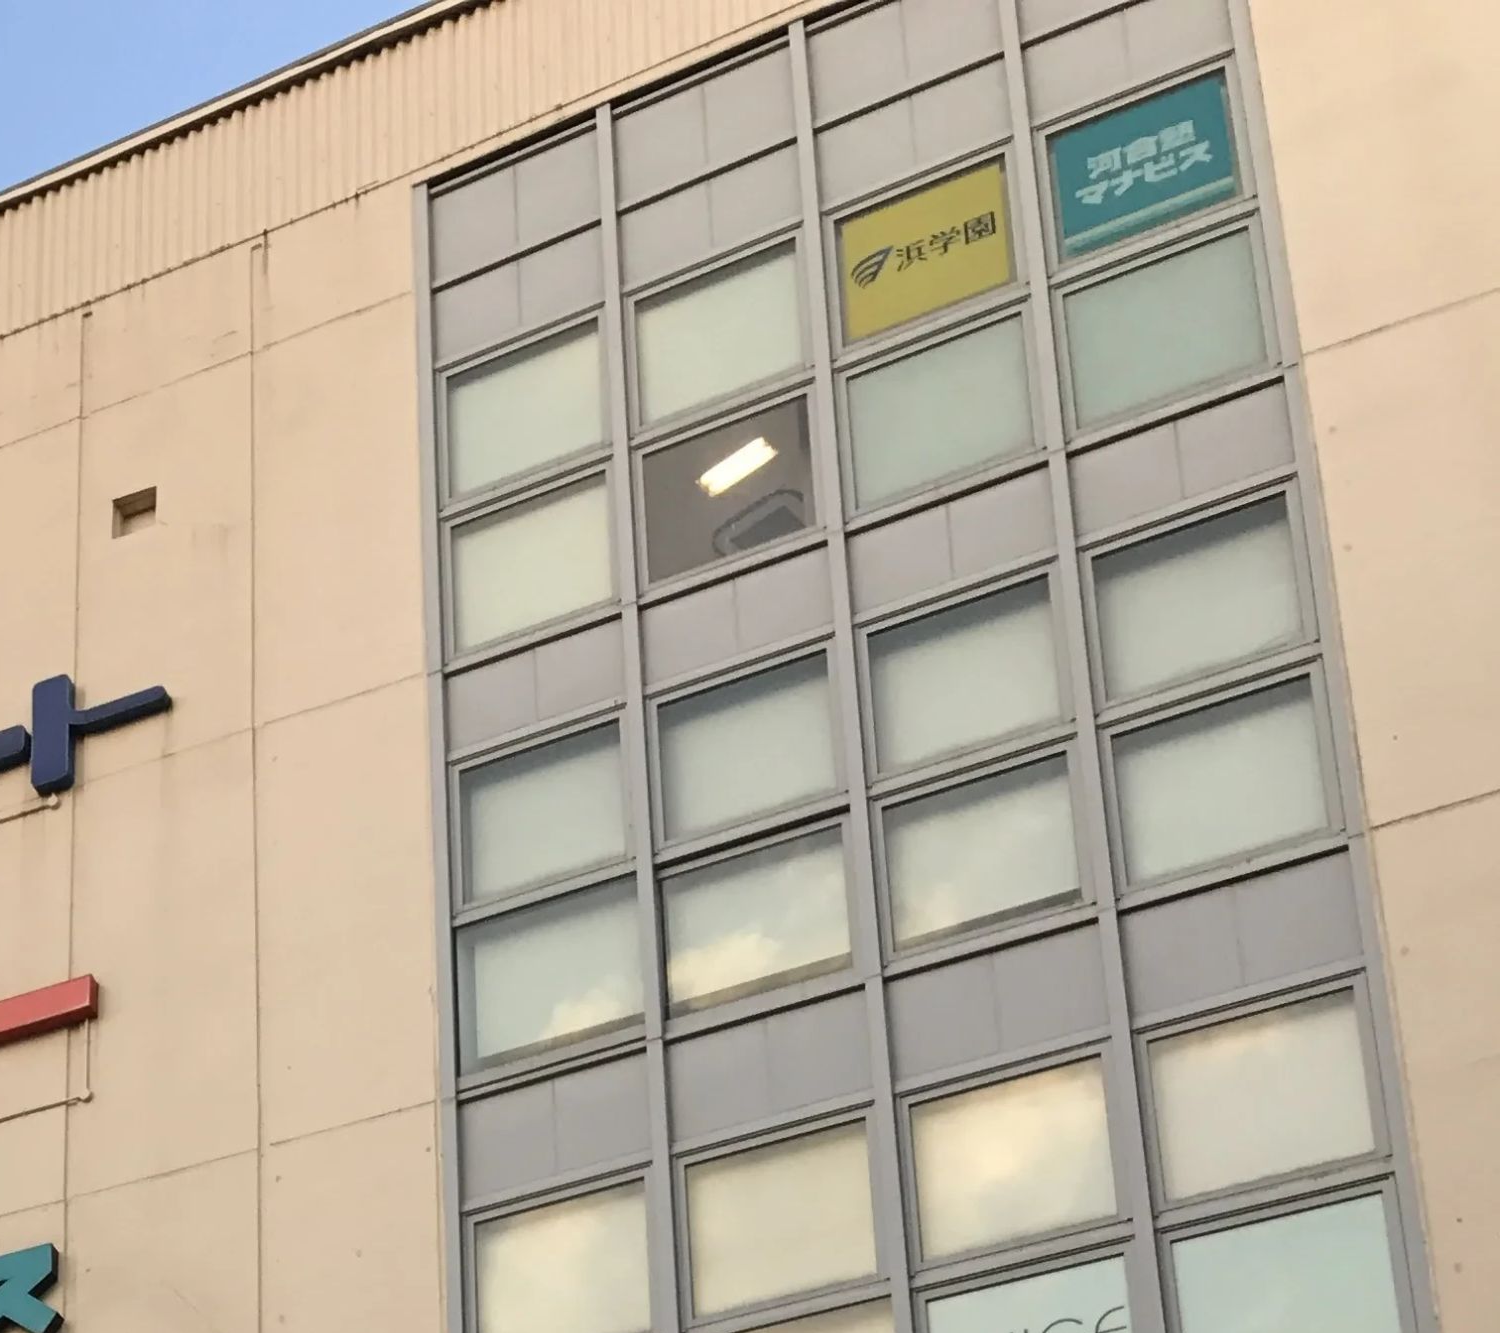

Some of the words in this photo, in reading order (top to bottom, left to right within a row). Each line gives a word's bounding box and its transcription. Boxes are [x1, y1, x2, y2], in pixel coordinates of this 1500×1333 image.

[1075, 140, 1213, 204] マナビス
[896, 211, 996, 272] 浜学園
